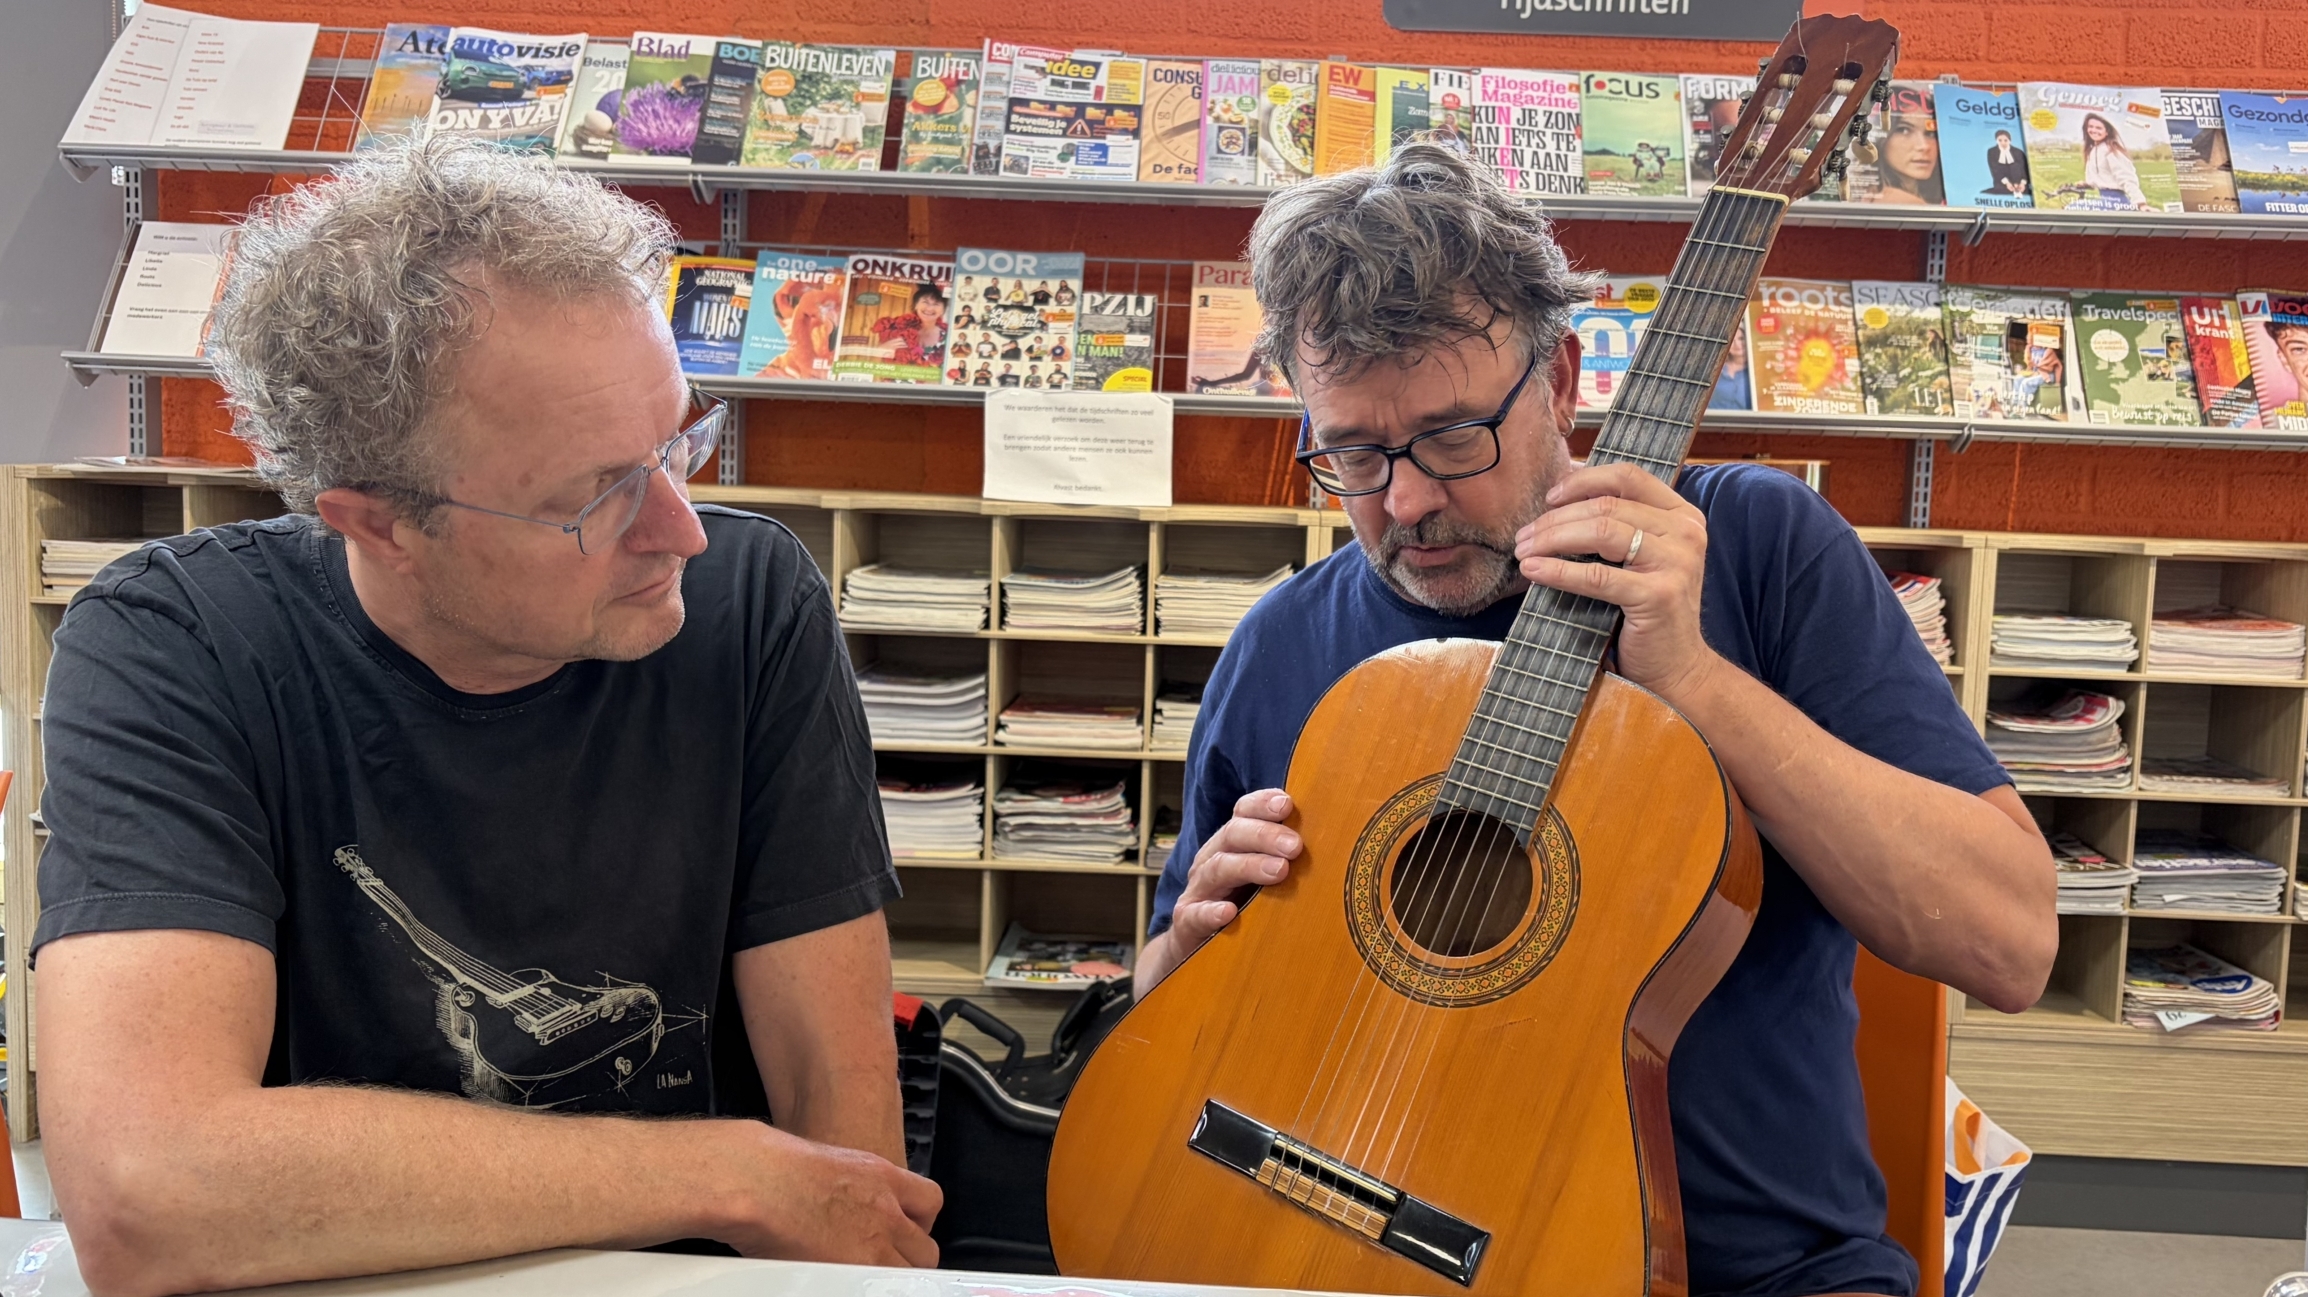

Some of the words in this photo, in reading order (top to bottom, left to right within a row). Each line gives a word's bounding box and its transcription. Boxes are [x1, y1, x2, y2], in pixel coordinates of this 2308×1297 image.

[452, 36, 581, 60] autovisie
[635, 37, 691, 59] Blad
[765, 45, 886, 77] BUITENLEVEN
[1328, 64, 1364, 86] EW
[1481, 75, 1567, 94] Filosofie
[1481, 89, 1578, 109] Magazine
[2037, 86, 2122, 113] Genoeg
[1473, 105, 1511, 126] KUN
[1516, 108, 1538, 127] JE
[1543, 111, 1581, 131] ZON
[1009, 124, 1063, 135] systemen
[1504, 127, 1546, 150] IETS
[1551, 132, 1576, 152] TE
[1530, 151, 1569, 173] AAN
[1534, 172, 1584, 194] DENK
[2265, 202, 2298, 213] FITTER
[777, 258, 817, 271] one
[960, 250, 1038, 275] OOR
[704, 269, 746, 280] NATIONAL
[762, 266, 837, 284] nature
[1081, 293, 1156, 317] PZIJ
[1758, 285, 1853, 313] roots
[2195, 324, 2236, 339] krant
[1089, 346, 1124, 357] MAN!
[1089, 407, 1129, 415] tijdschriften
[1773, 396, 1857, 413] ZINDERENDE
[1052, 416, 1078, 424] gelezen
[1003, 433, 1015, 441] Een
[1017, 434, 1051, 442] vriendelijk
[1127, 438, 1146, 446] terug
[1004, 444, 1031, 452] brengen
[656, 1073, 667, 1089] LA
